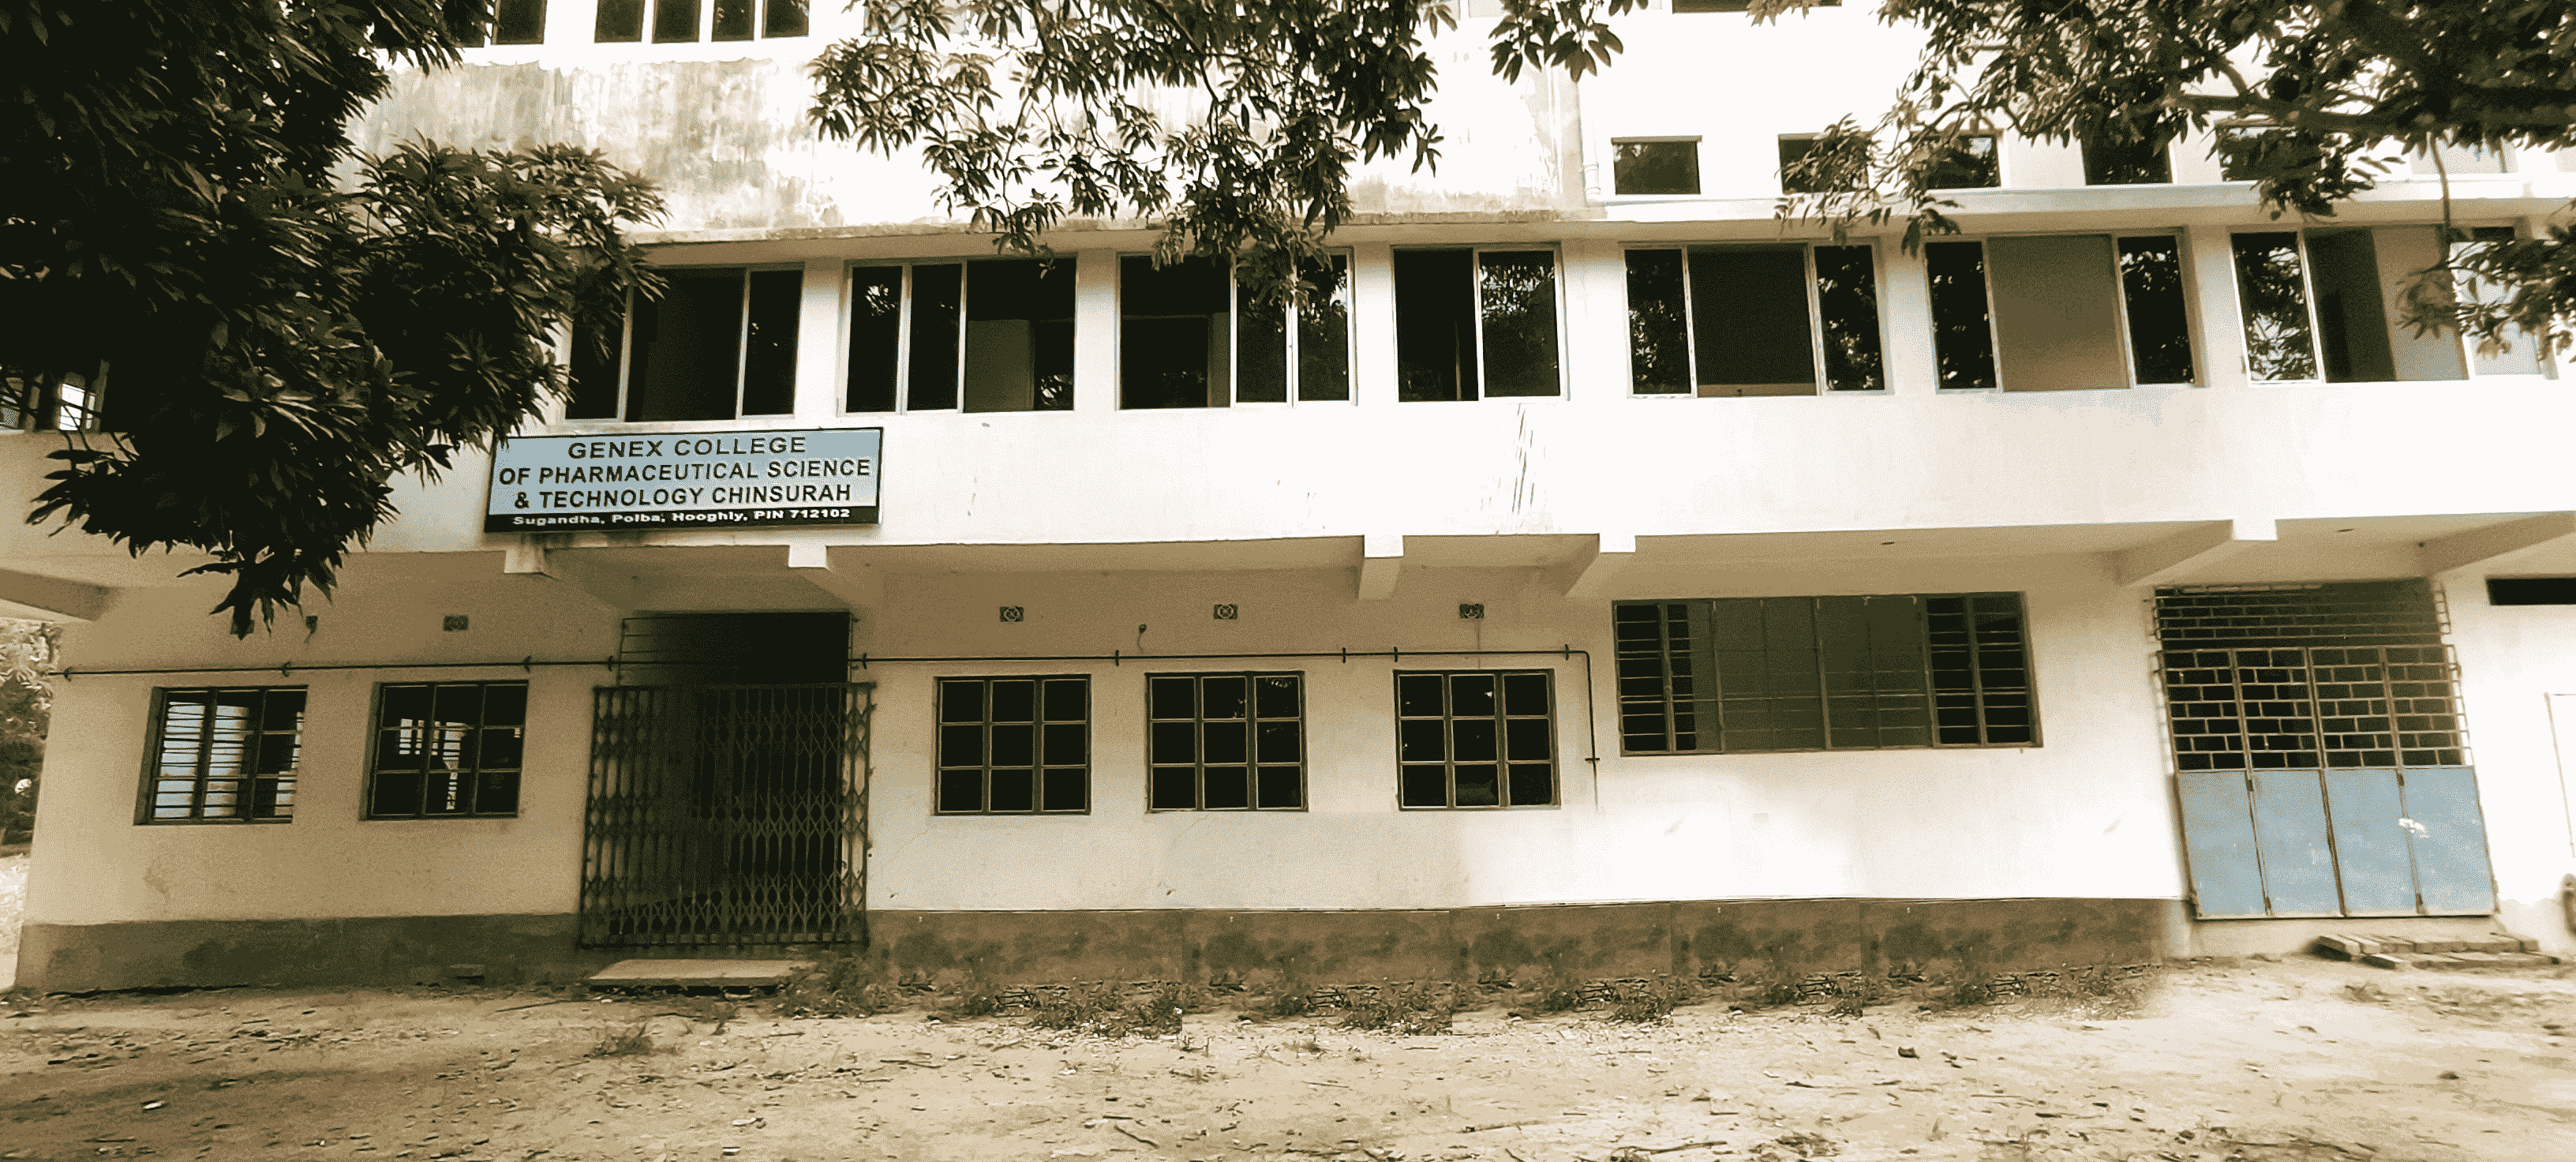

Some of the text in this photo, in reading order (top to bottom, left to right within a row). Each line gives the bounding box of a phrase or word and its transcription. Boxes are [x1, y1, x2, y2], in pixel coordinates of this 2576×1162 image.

[568, 437, 807, 459] GENEX COLLEGE
[499, 459, 871, 485] OF PHARMACEUTICAL SCIENCE
[514, 484, 852, 509] & TECHNOLOGY CHINSURAH
[513, 515, 605, 527] Sugandha,
[672, 512, 747, 523] Hooghly,
[754, 510, 784, 519] PIN
[790, 509, 850, 519] 712102
